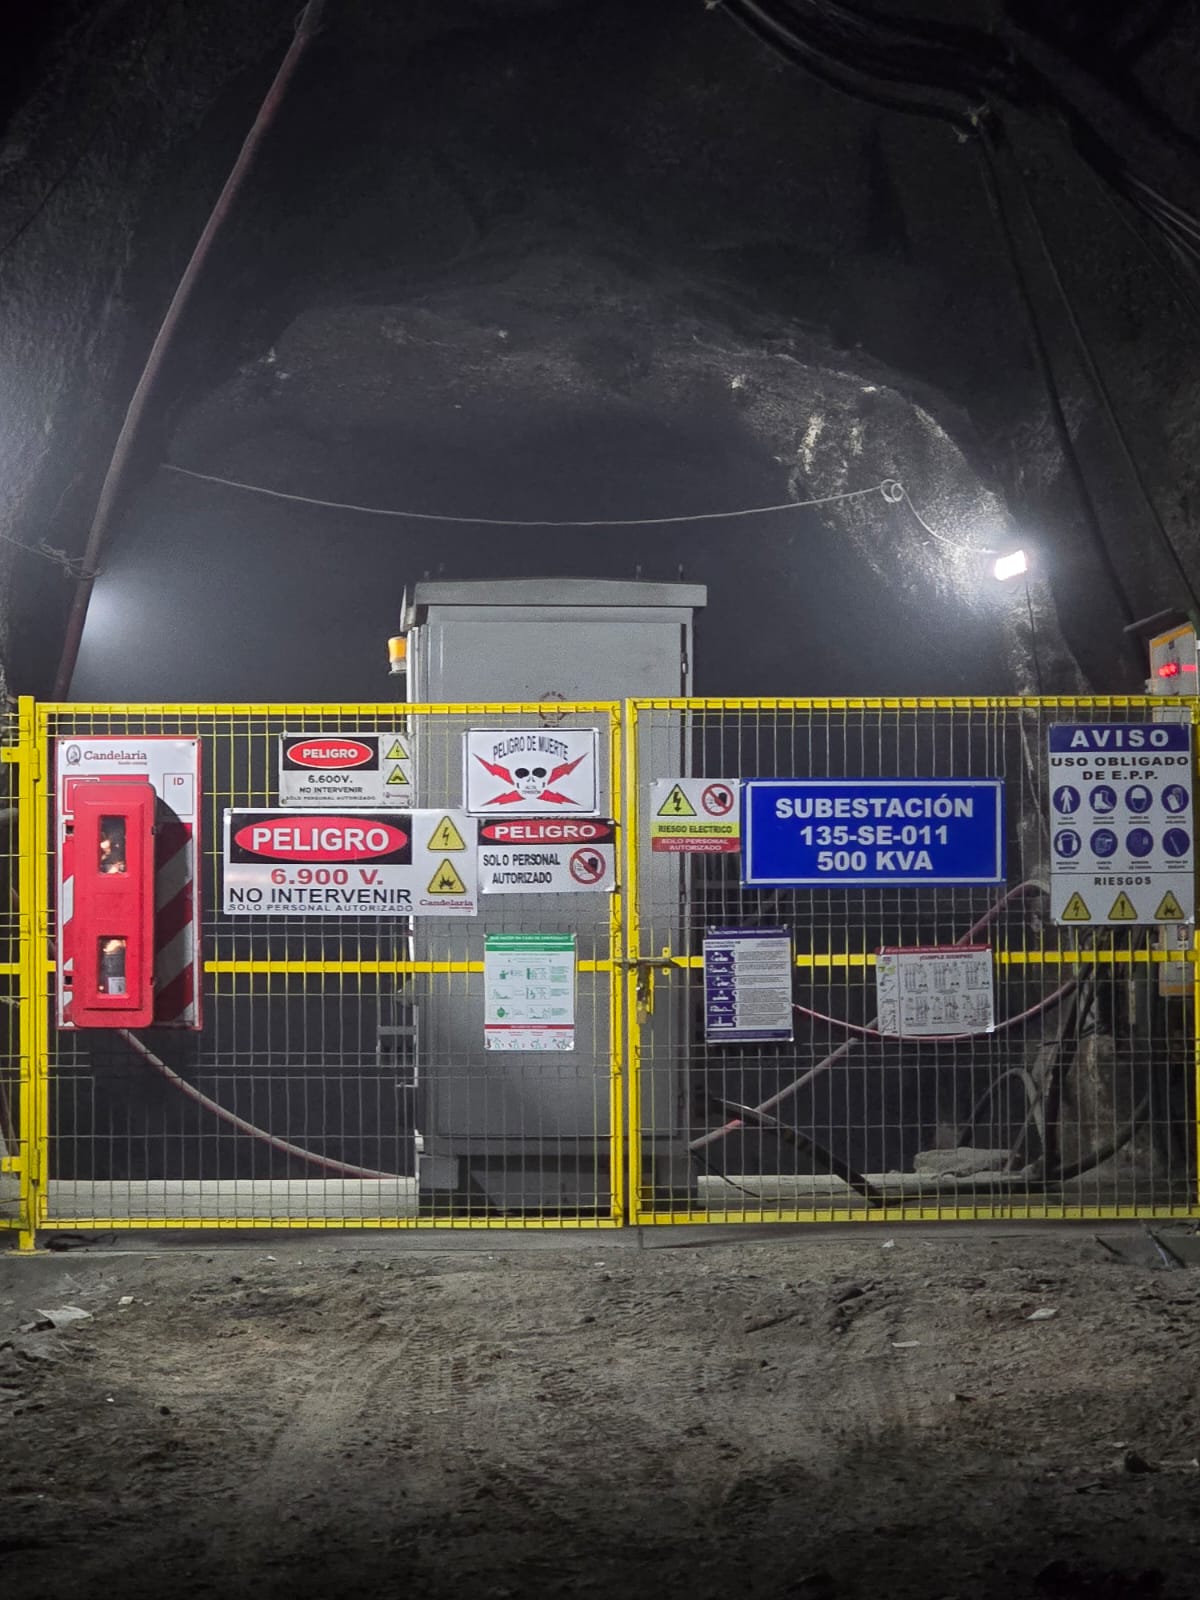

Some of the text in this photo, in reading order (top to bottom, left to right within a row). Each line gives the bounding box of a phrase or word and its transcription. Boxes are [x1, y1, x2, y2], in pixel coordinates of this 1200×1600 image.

[1070, 729, 1169, 748] AVISO
[302, 748, 359, 759] PELIGRO
[493, 735, 568, 761] PELIGRO DE MUERTE
[83, 750, 148, 761] Candelaria
[1051, 756, 1189, 767] USO OBLIGADO
[172, 777, 185, 786] ID
[1082, 770, 1158, 780] DE E.P.P.
[775, 794, 974, 819] SUBESTACIÓN
[494, 824, 597, 839] PELIGRO
[658, 825, 687, 833] RIESGO
[799, 825, 948, 846] 135-SE-011
[252, 827, 390, 851] PELIGRO
[483, 853, 561, 866] SOLO PERSONAL
[816, 851, 934, 871] 500 KVA
[271, 868, 384, 886] 6.900 V.
[492, 871, 553, 885] AUTORIZADO
[1094, 876, 1152, 886] RIESGOS
[229, 887, 412, 904] NO INTERVENIR
[266, 904, 331, 912] PERSONAL
[335, 904, 413, 912] AUTORIZADO
